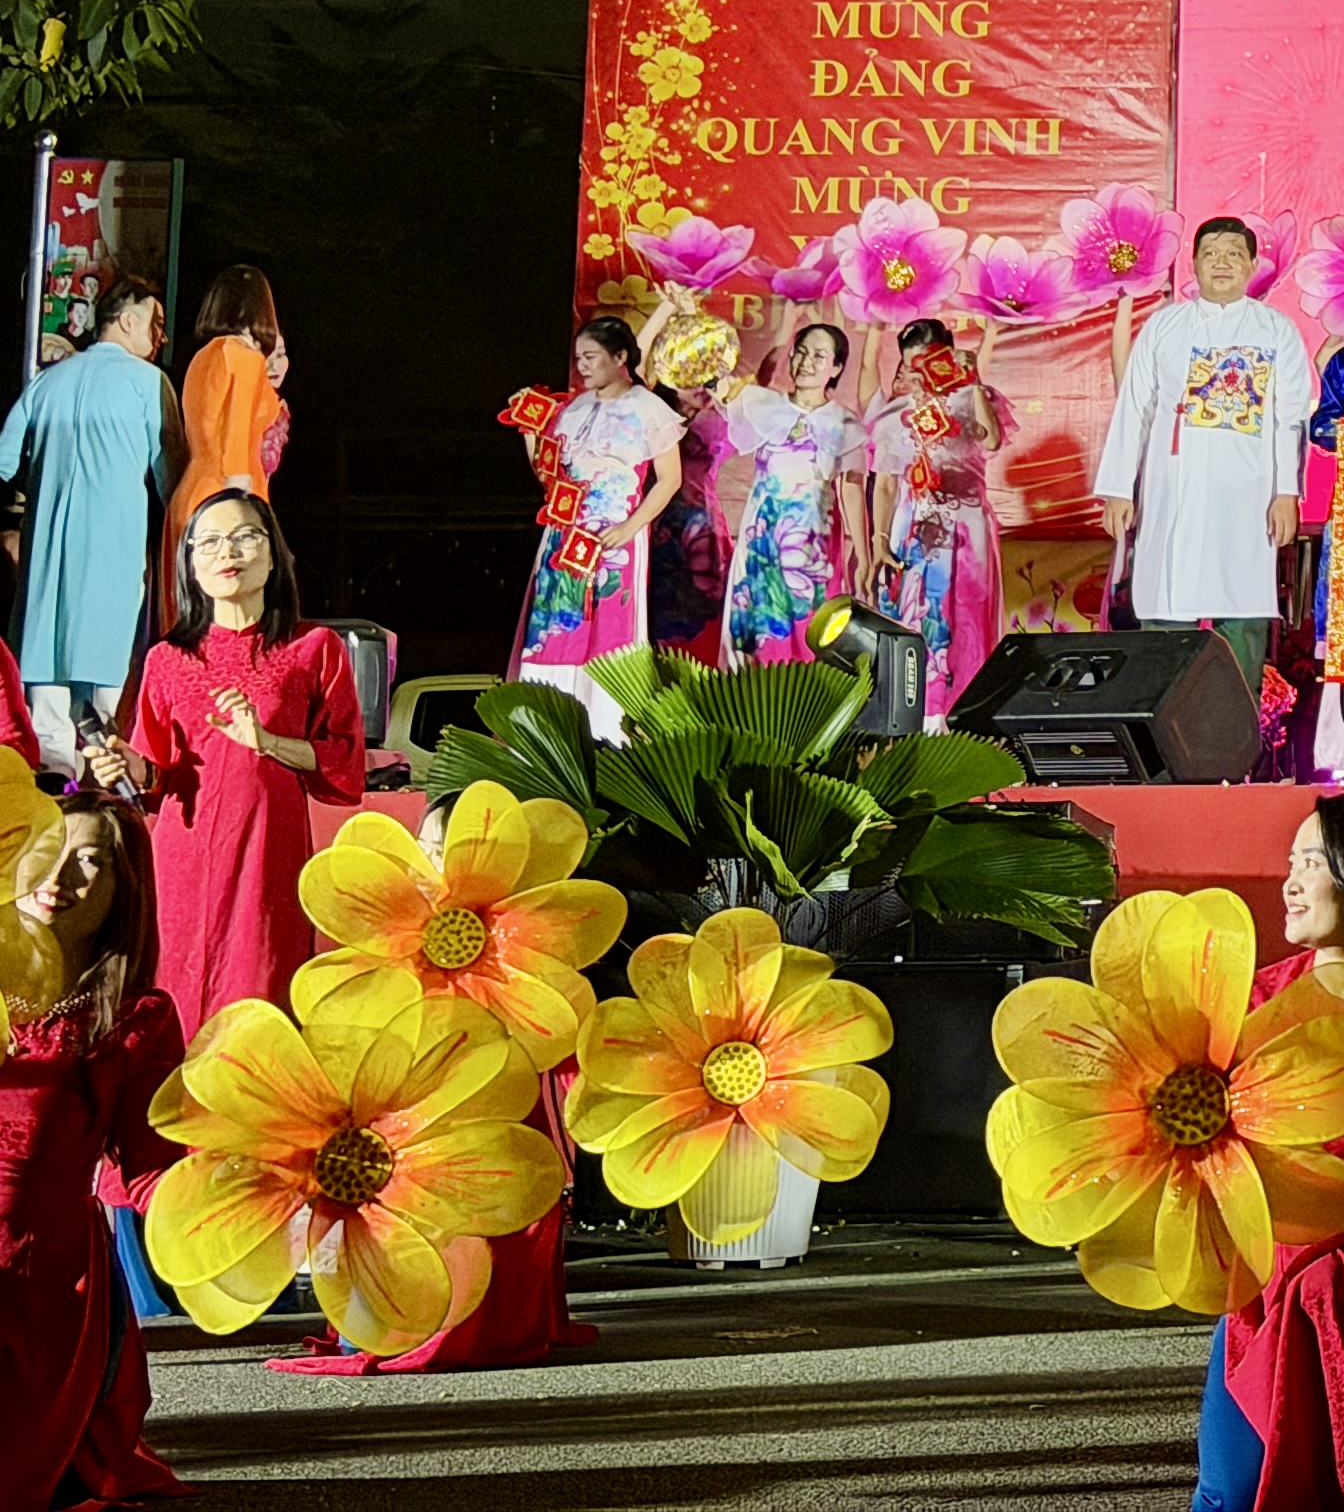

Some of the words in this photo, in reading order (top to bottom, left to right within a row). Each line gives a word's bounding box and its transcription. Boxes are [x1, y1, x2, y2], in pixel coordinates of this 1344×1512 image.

[809, 48, 973, 97] ĐẢNG
[697, 117, 901, 163] QUANG
[919, 118, 1063, 156] VINH
[790, 165, 972, 215] MỪNG
